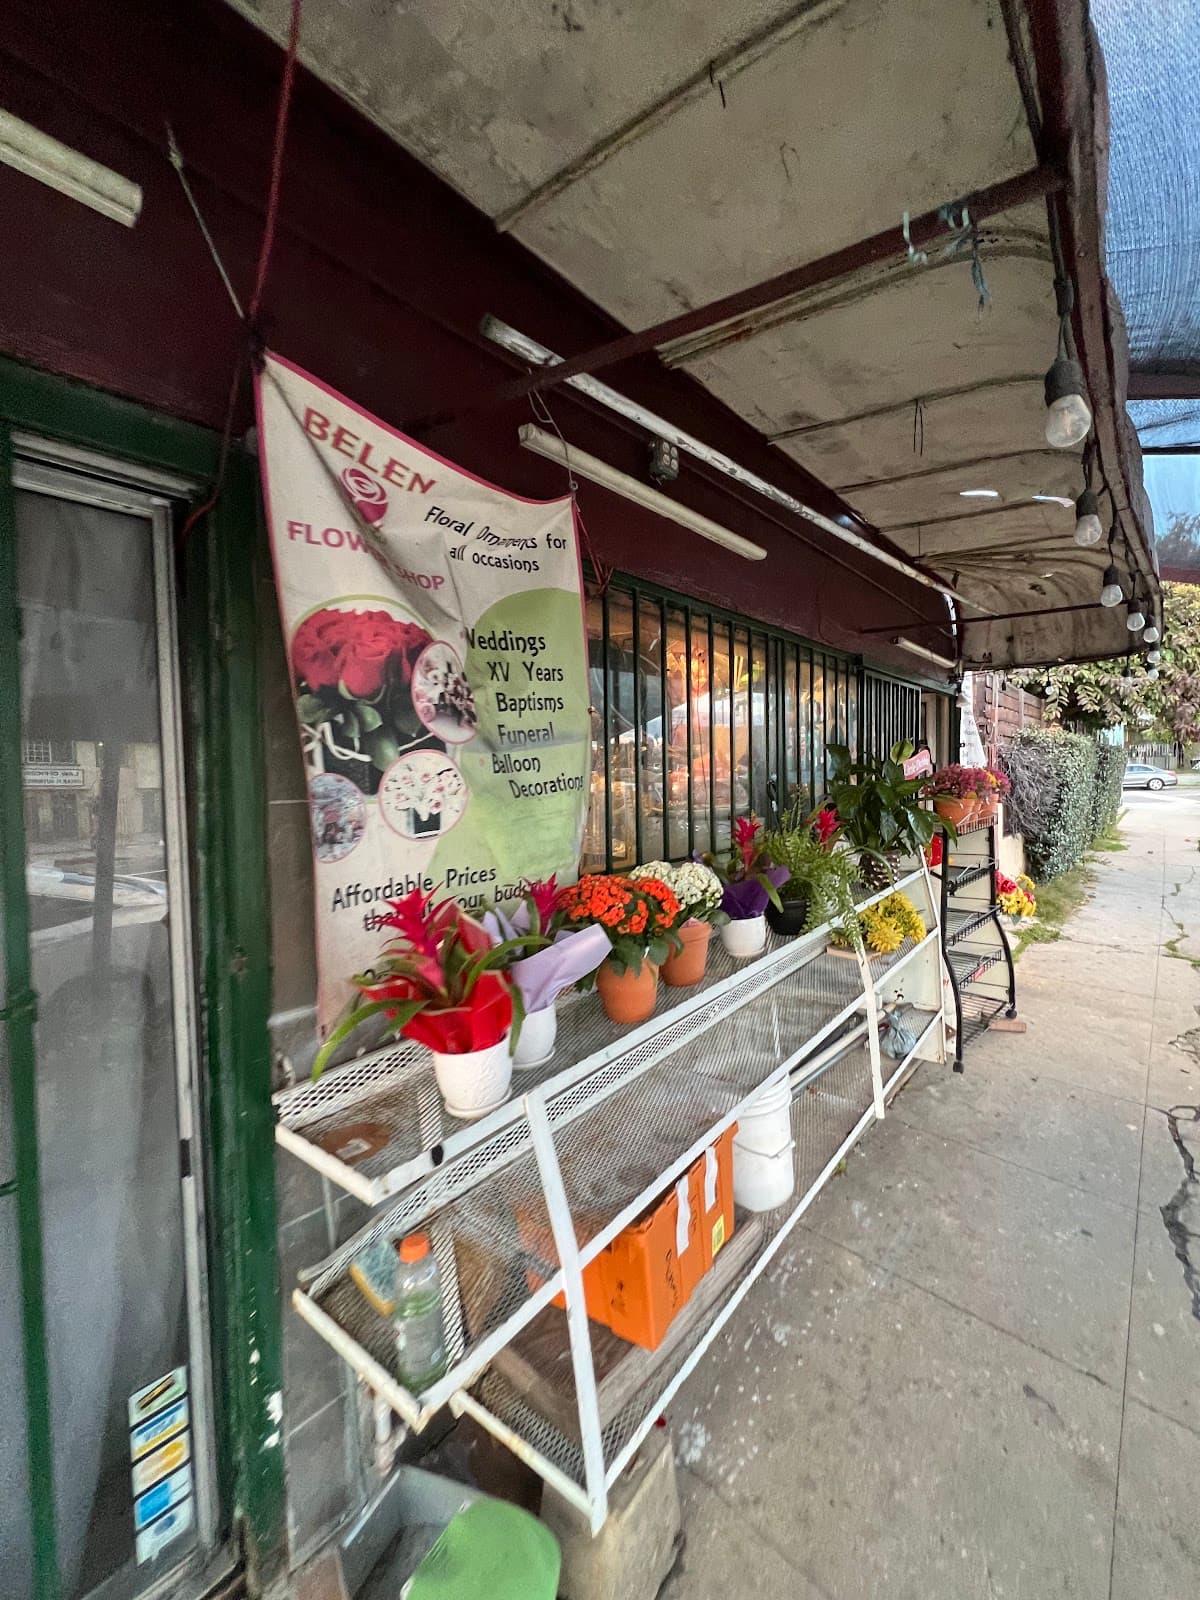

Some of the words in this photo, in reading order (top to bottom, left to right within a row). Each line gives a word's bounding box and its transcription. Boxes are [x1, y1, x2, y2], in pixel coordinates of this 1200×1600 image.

[304, 407, 436, 494] BELEN
[424, 506, 475, 536] Floral
[546, 533, 567, 550] for
[450, 545, 467, 561] all
[472, 552, 540, 573] occasions
[487, 661, 509, 682] XV
[522, 661, 564, 682] Years
[495, 692, 564, 718] Baptisms
[497, 721, 555, 746] Funeral
[492, 753, 541, 774] Balloon
[332, 872, 434, 913] Affordable
[446, 866, 496, 888] Prices
[457, 894, 485, 909] our
